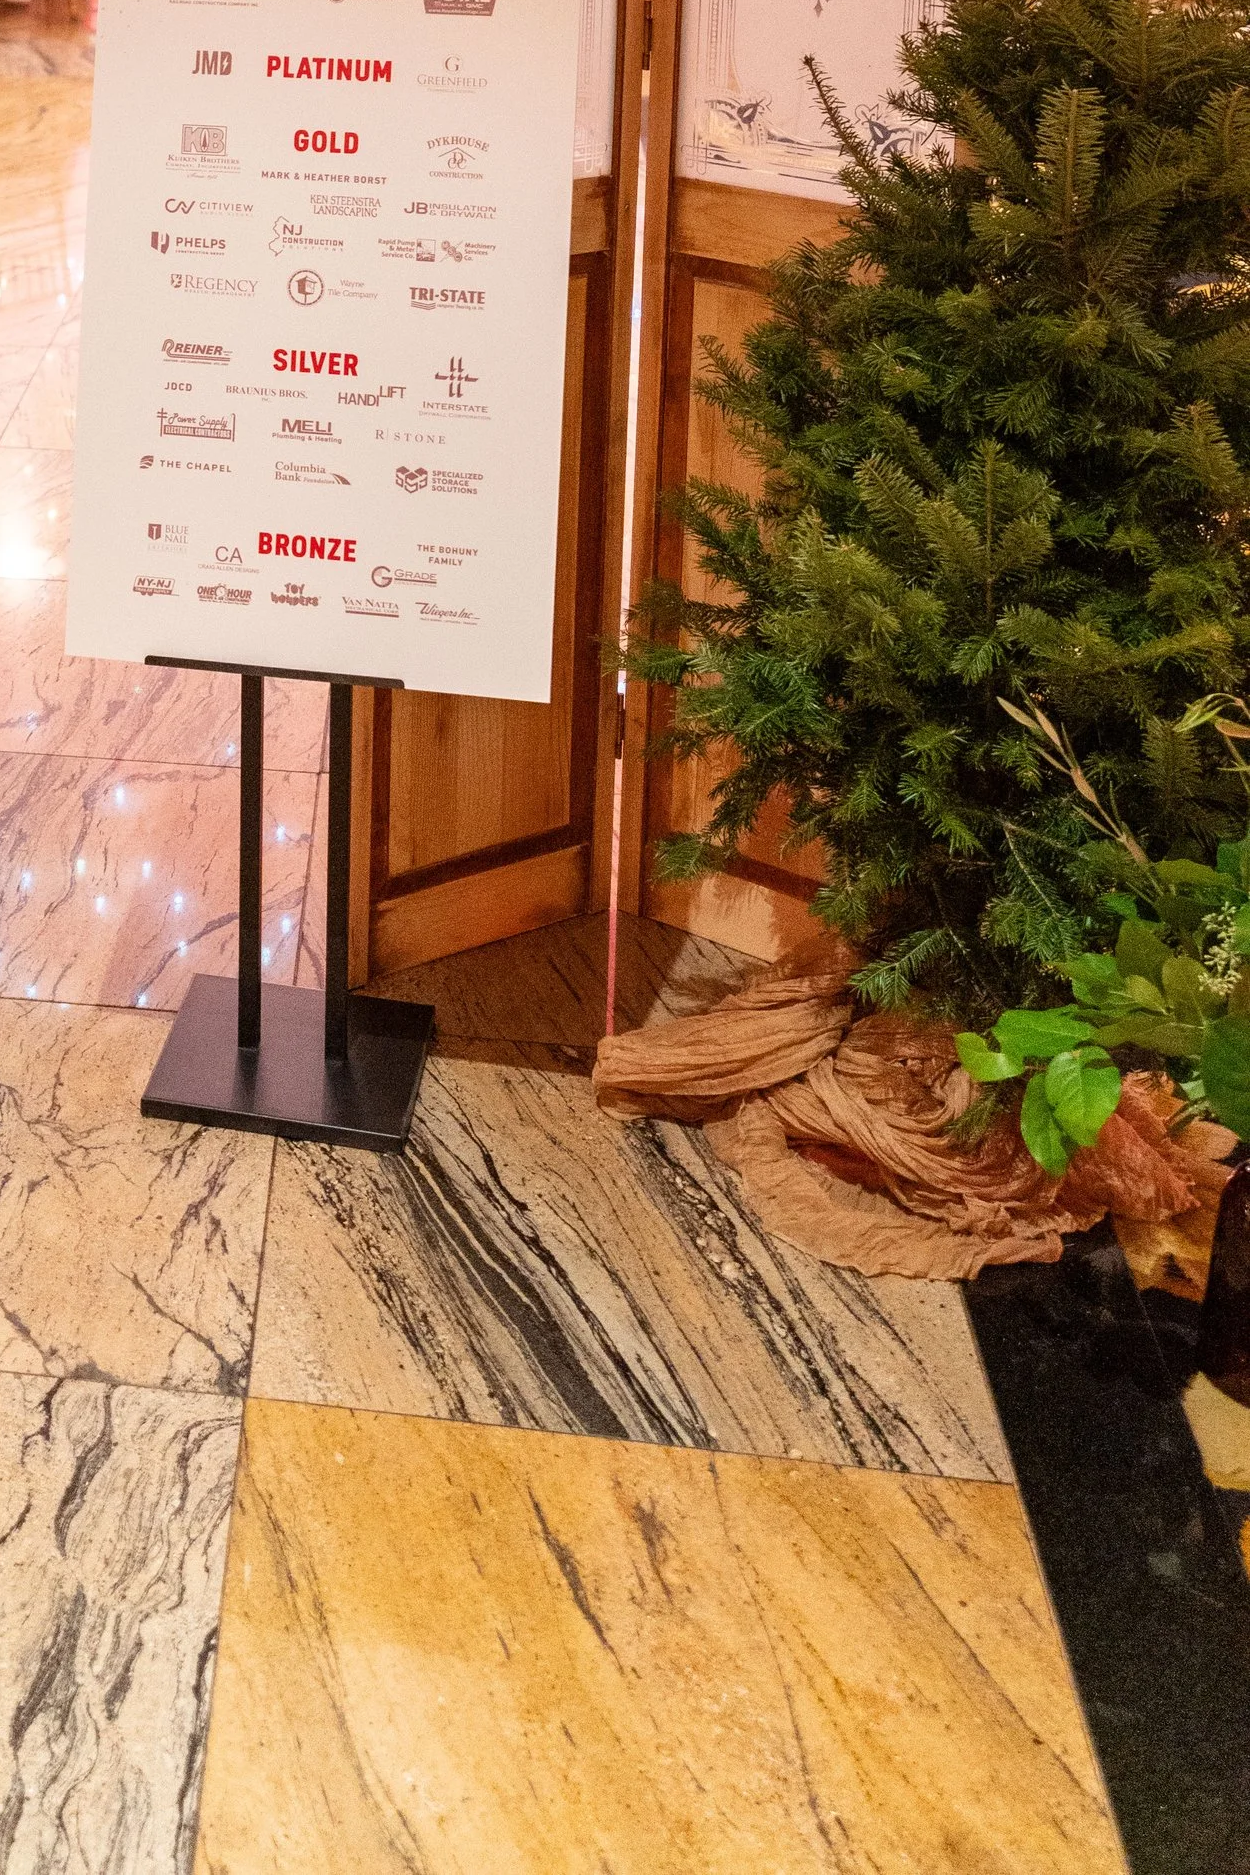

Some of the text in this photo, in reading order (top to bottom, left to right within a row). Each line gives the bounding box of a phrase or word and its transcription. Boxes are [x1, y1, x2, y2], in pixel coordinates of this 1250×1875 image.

[192, 50, 233, 76] JMD
[266, 55, 392, 83] PLATINUM
[293, 129, 359, 154] GOLD
[426, 136, 490, 152] DYKHOUSE
[261, 170, 387, 185] MARK & HEATHER BORST
[429, 170, 483, 180] CONSTRUCTION
[200, 201, 254, 212] CITIVIEW
[310, 194, 381, 208] KEN STEENSTRA
[313, 205, 378, 218] LANDSCAPING
[404, 201, 428, 215] JB
[283, 224, 303, 236] NJ
[176, 237, 226, 250] PHELPS
[282, 237, 344, 247] CONSTRUCTION
[185, 275, 259, 293] REGENCY
[409, 287, 486, 305] TRI-STATE
[174, 342, 224, 356] REINER
[273, 348, 359, 376] SILVER
[164, 381, 192, 392] JDCD
[422, 400, 488, 414] INTERSTATE
[282, 418, 332, 433] MELI
[159, 459, 232, 473] THE CHAPEL
[275, 461, 326, 474] Columbia
[275, 471, 301, 483] Bank
[432, 470, 484, 481] SPECIALIZED
[432, 478, 470, 487] STORAGE
[432, 485, 478, 495] SOLUTIONS
[165, 524, 190, 535] BLUE
[164, 534, 188, 545] NAIL
[258, 532, 357, 562] BRONZE
[417, 544, 479, 556] THE BOHUNY
[428, 556, 463, 566] FAMILY
[394, 568, 438, 581] GRADE
[137, 577, 171, 589] NY-NJ
[227, 588, 252, 600] HOUR
